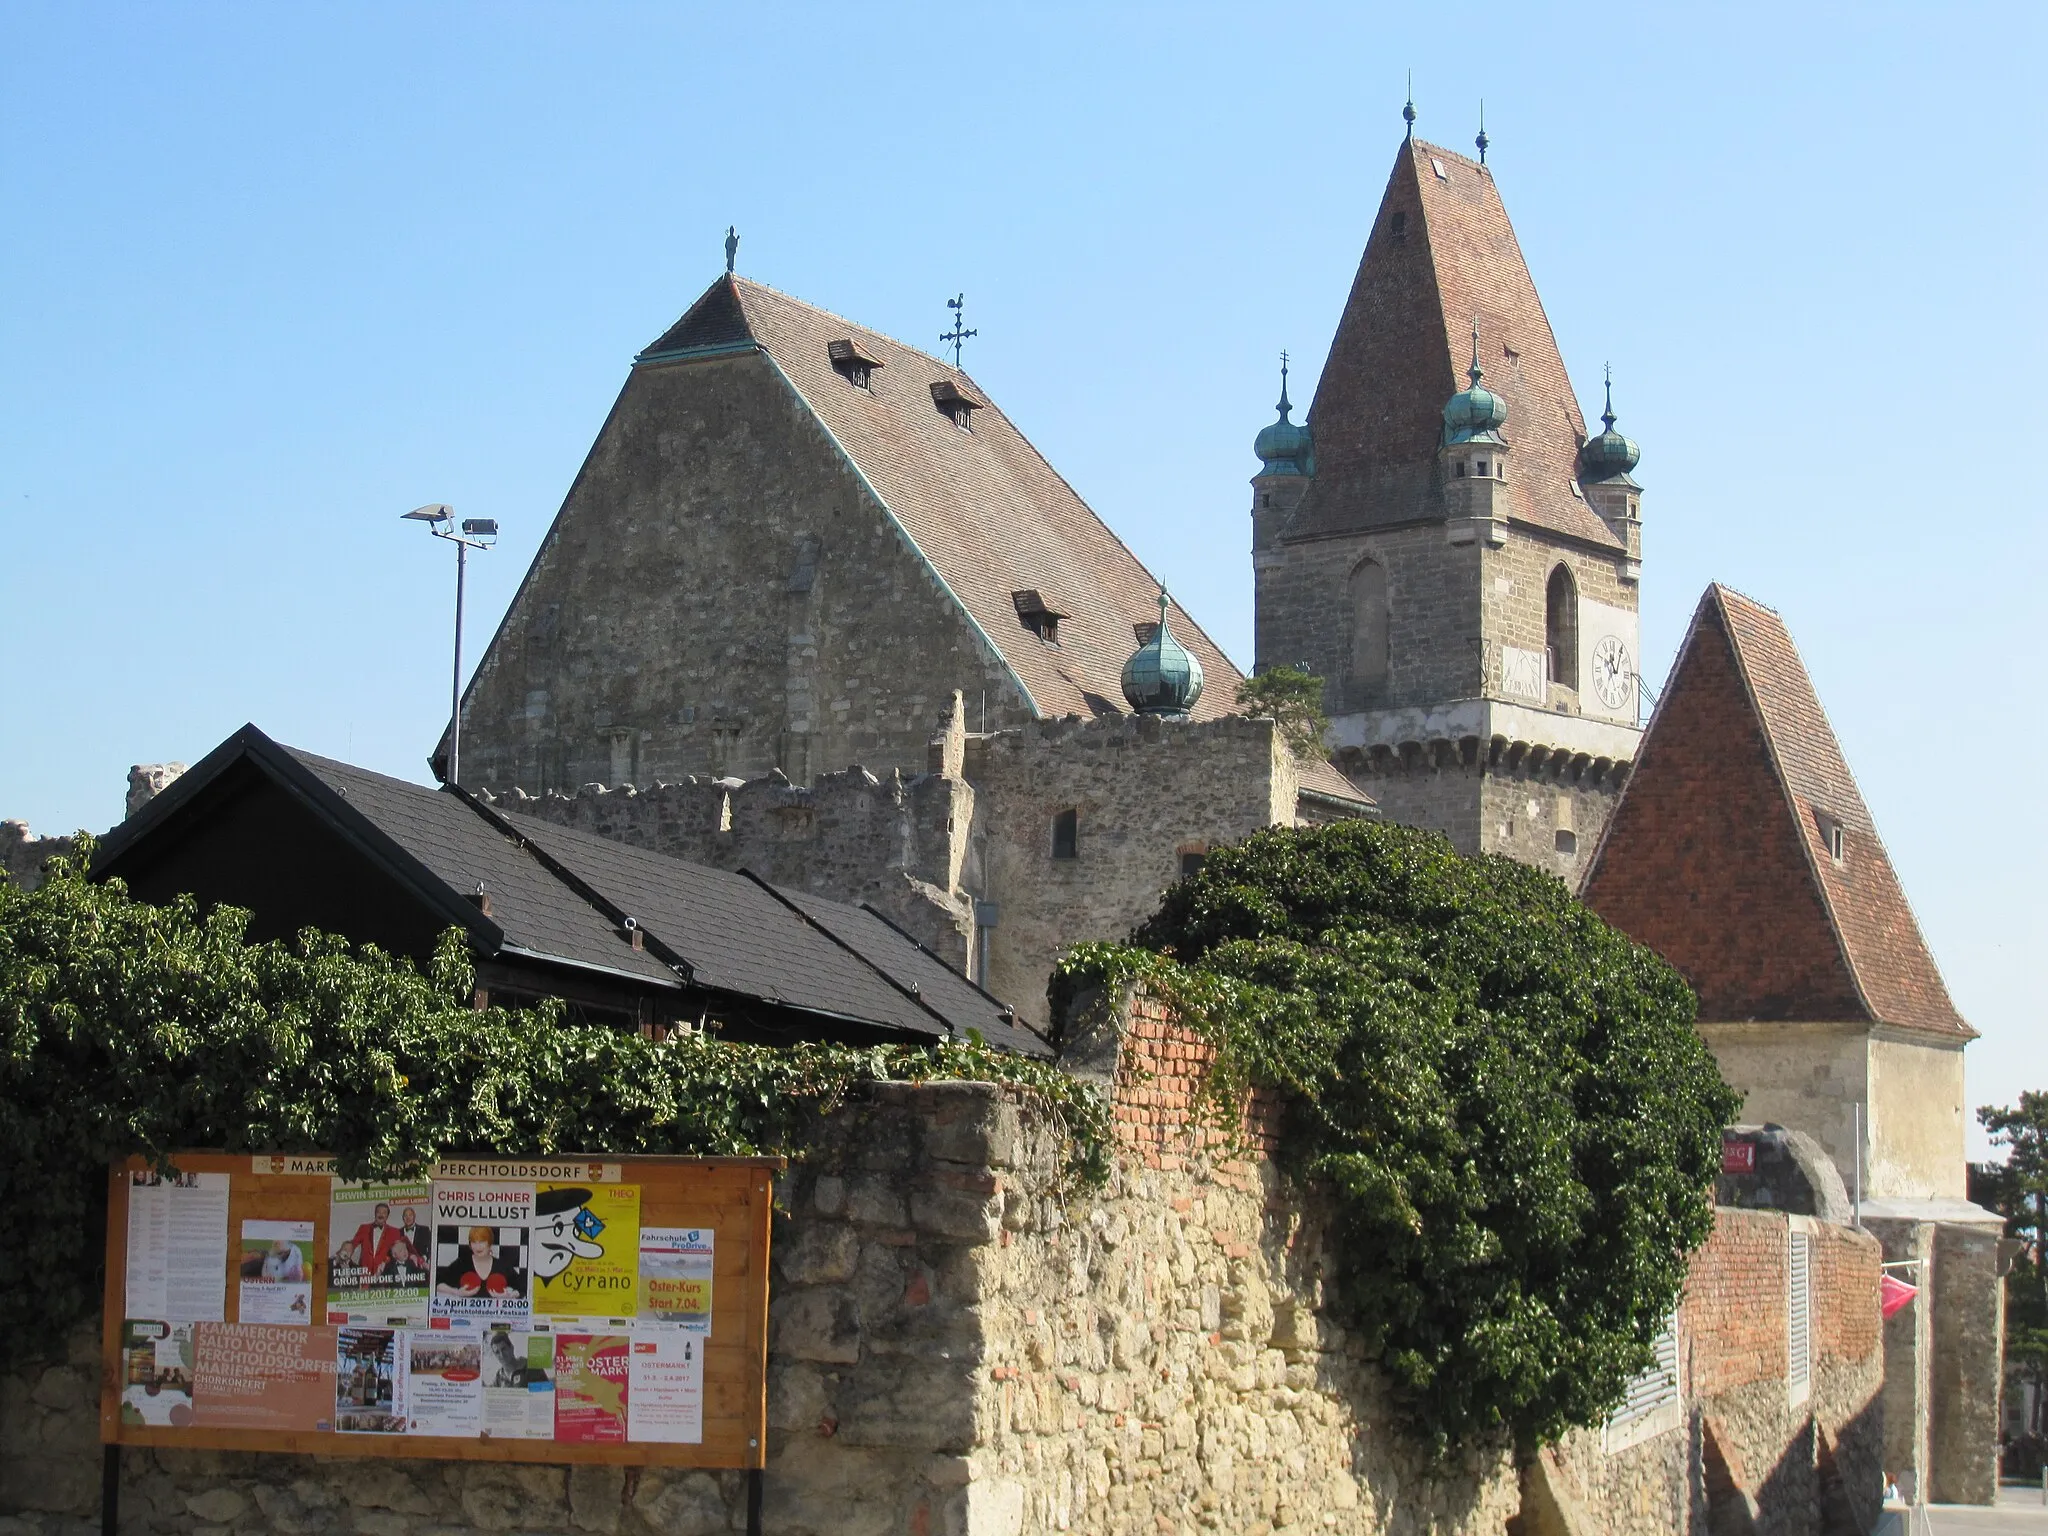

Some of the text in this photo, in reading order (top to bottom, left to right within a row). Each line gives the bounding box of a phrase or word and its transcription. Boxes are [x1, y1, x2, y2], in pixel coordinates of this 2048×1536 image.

[440, 1164, 581, 1178] PERCHTOLDSDORF
[335, 1187, 426, 1201] ERWIN STEINHAUER
[438, 1191, 530, 1203] CHRIS LOHNER
[439, 1205, 530, 1220] WOLLLUST
[641, 1233, 687, 1242] Fahrschule
[333, 1267, 371, 1277] FLIEGER,
[360, 1275, 378, 1284] MIR
[379, 1274, 393, 1283] DIE
[563, 1271, 631, 1292] Cyrano
[649, 1280, 702, 1293] Oster-Kurs
[352, 1290, 369, 1301] April
[370, 1289, 392, 1300] 2017
[393, 1287, 419, 1298] 20:00
[444, 1299, 467, 1309] April
[470, 1300, 492, 1308] 2017
[502, 1300, 529, 1309] 20:00
[649, 1296, 673, 1309] Start
[200, 1322, 308, 1344] KAMMERCHOR
[199, 1335, 302, 1357] SALTO VOCALE
[197, 1347, 338, 1374] PERCHTOLDSDORFER
[586, 1356, 630, 1369] OSTER
[590, 1366, 630, 1376] MARKT
[194, 1374, 266, 1390] CHORKONZERT
